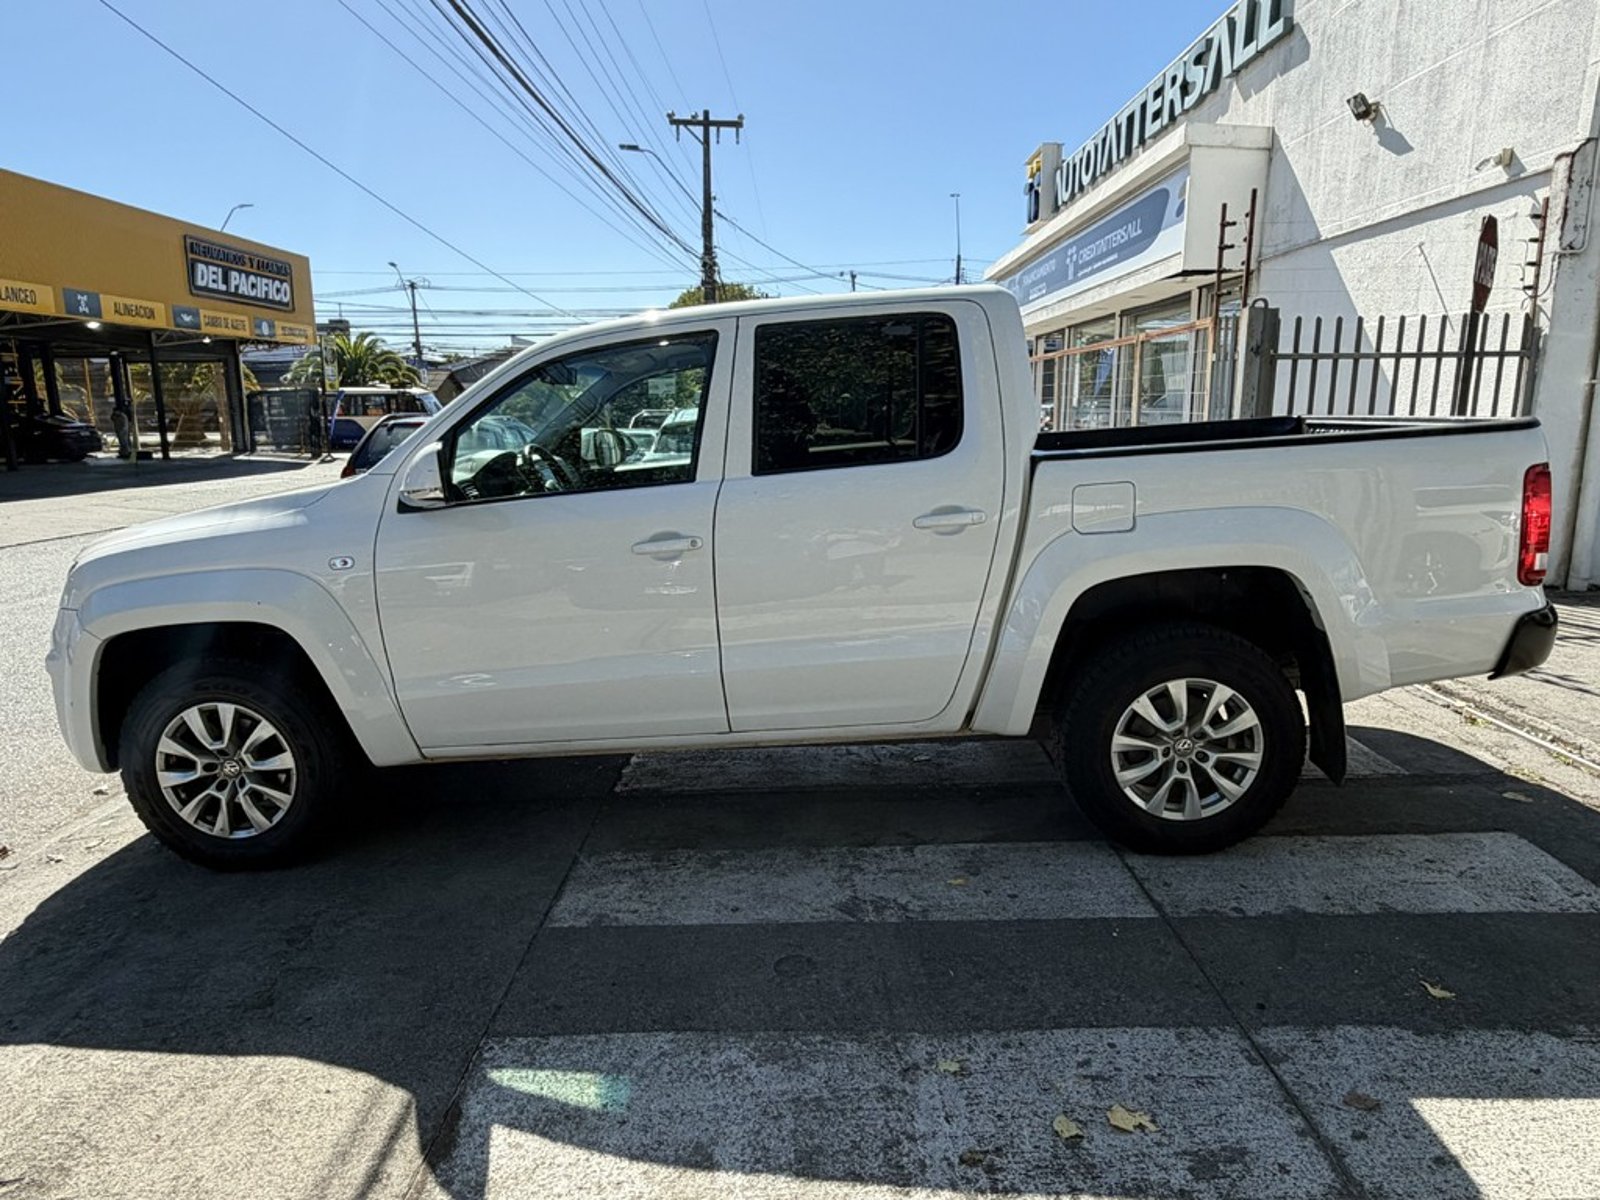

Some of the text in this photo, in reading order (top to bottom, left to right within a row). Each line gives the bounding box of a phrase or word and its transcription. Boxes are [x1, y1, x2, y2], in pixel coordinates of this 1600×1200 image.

[194, 263, 290, 303] DEL PACIFICO
[114, 302, 156, 320] ALINEACION
